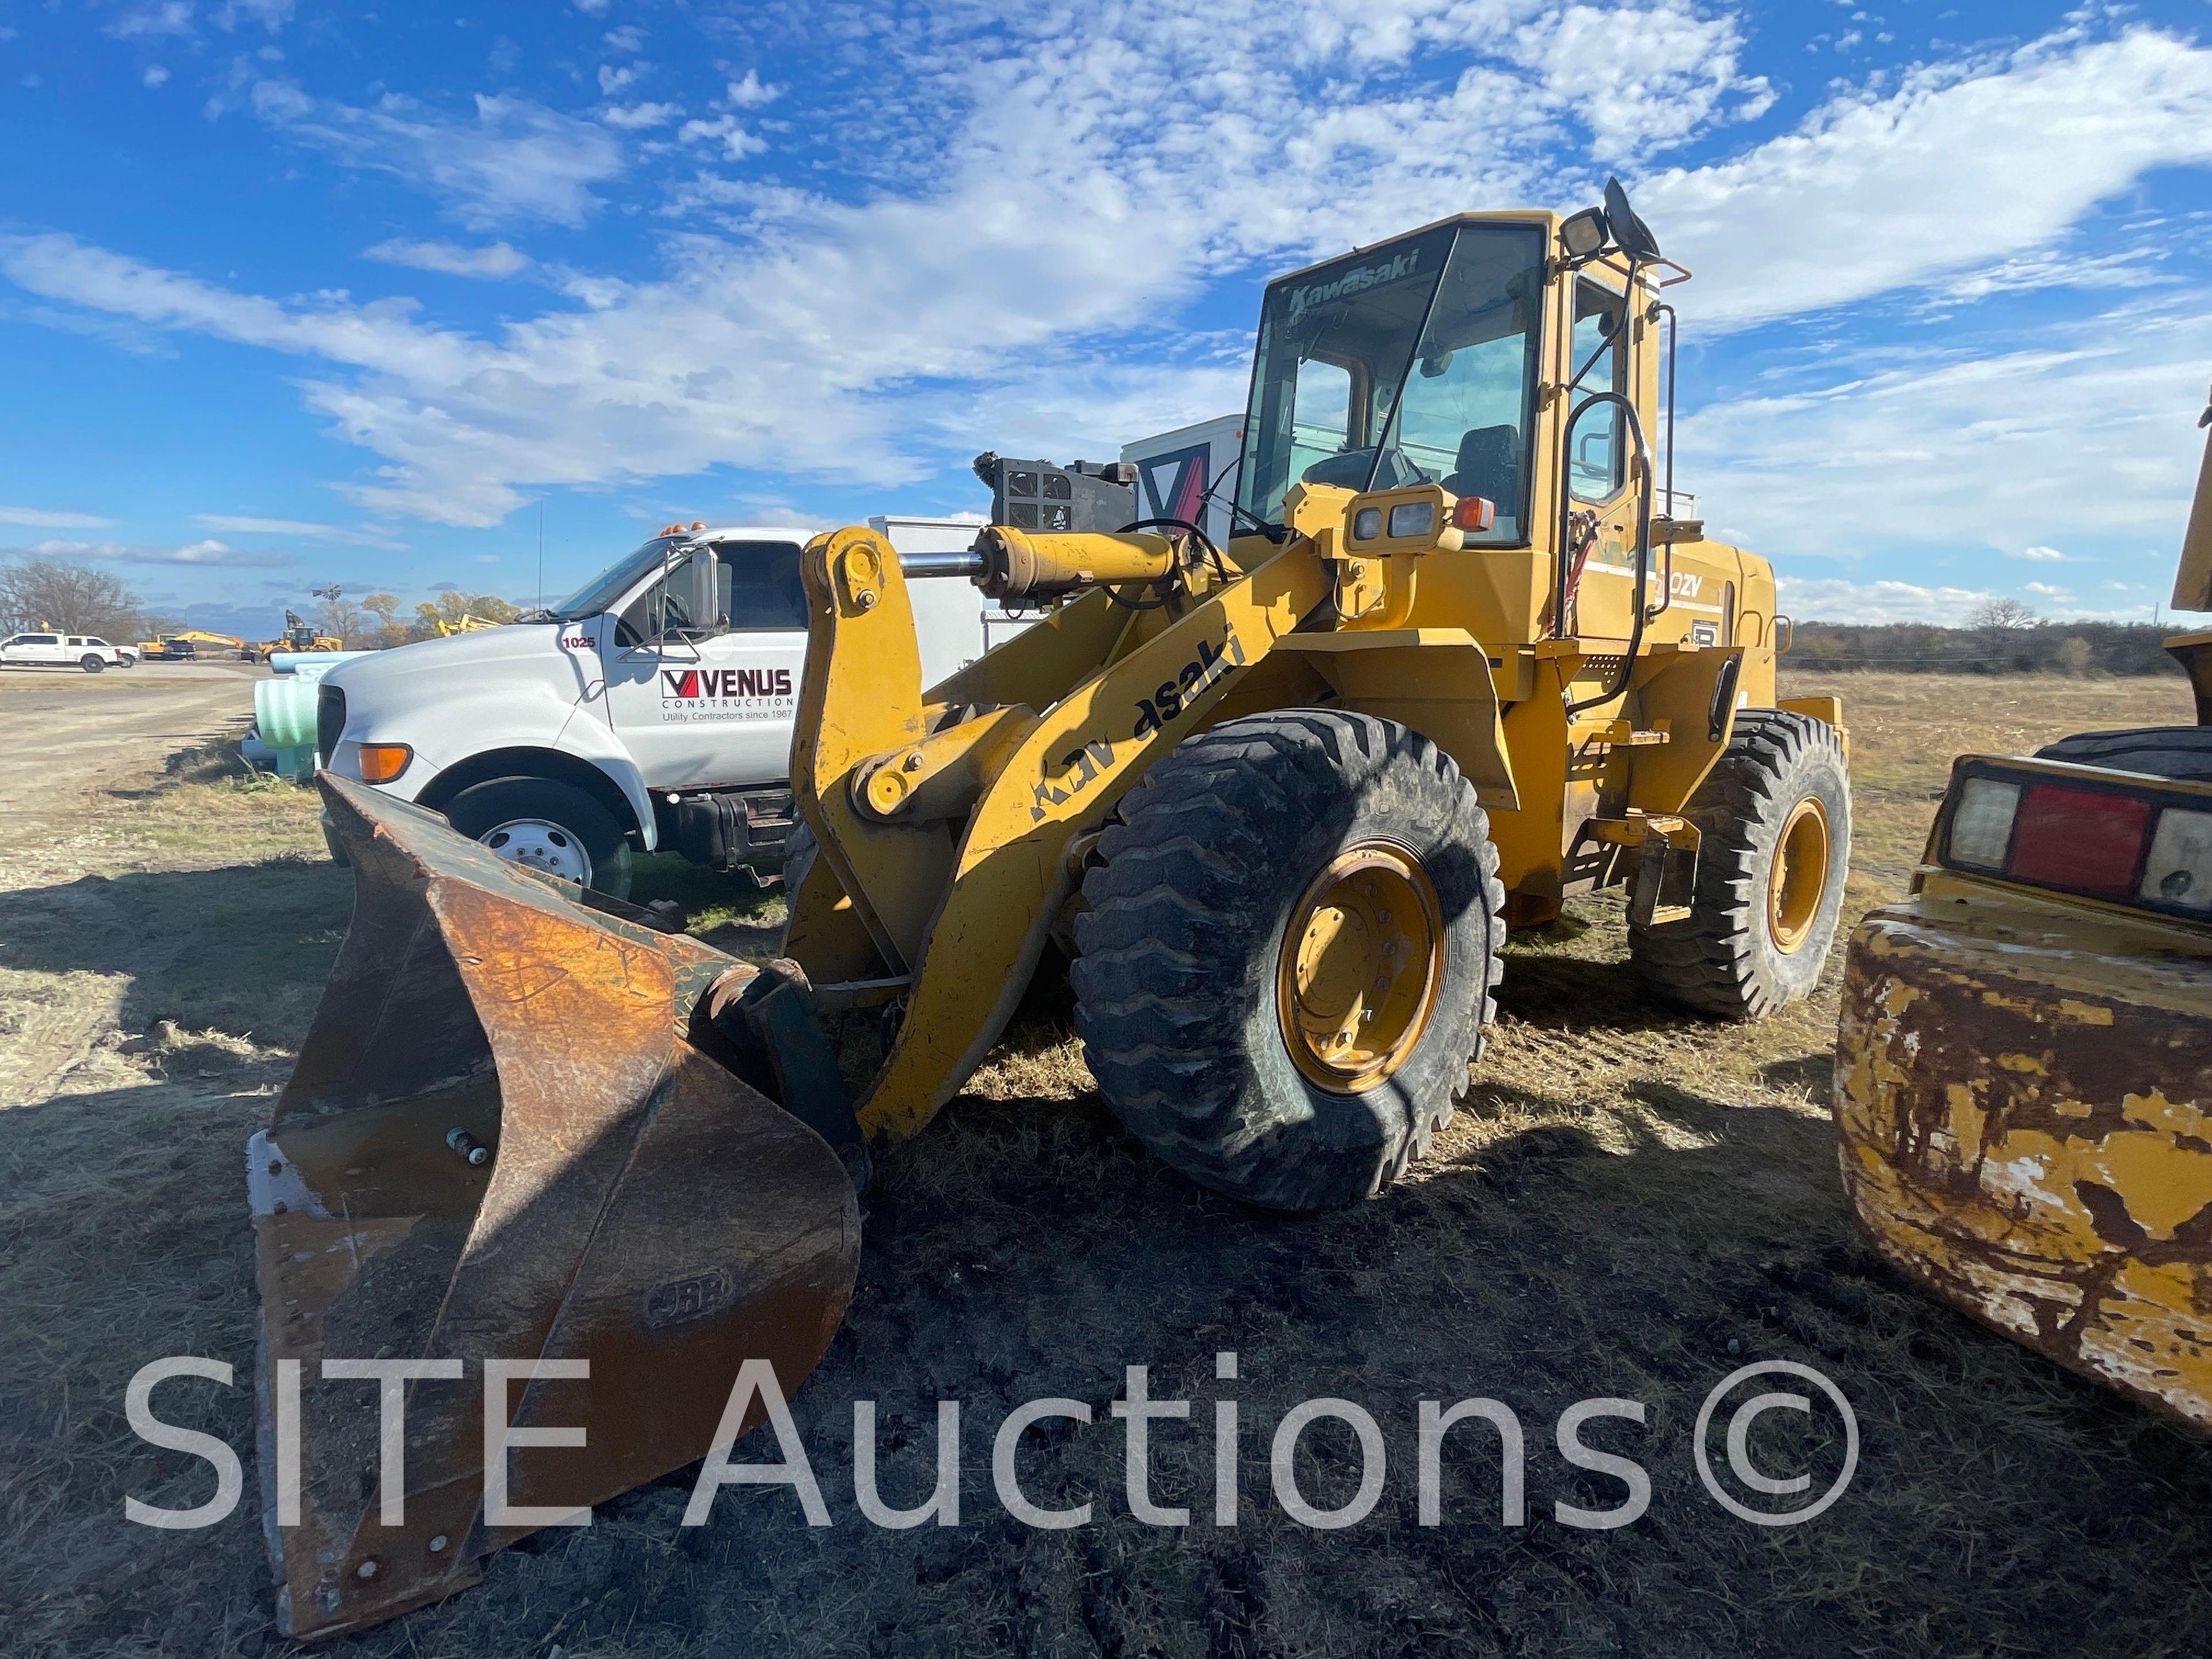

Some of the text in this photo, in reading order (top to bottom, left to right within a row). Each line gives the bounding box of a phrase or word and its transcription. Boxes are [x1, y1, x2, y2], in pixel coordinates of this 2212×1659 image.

[1289, 248, 1421, 312] Kawasaki
[562, 637, 595, 648] 1025
[700, 669, 792, 697] VENUS
[662, 698, 793, 708] CONSTRUCTION
[663, 710, 792, 722] Utility Contractors since 1967
